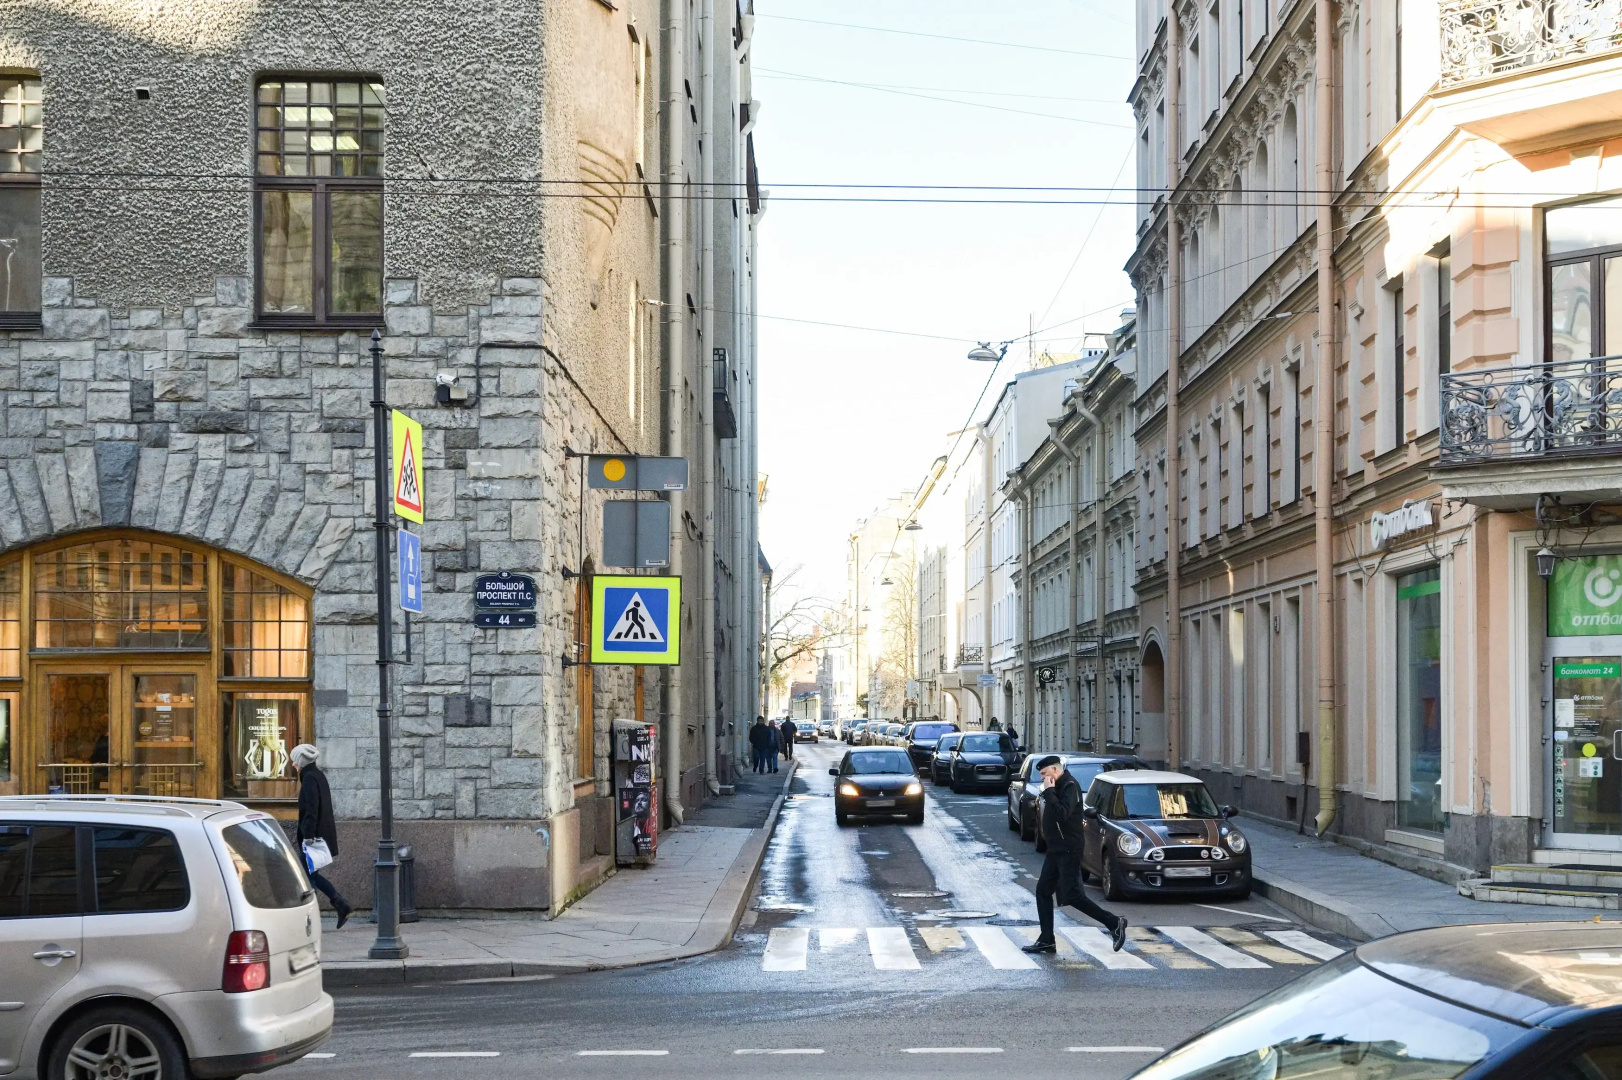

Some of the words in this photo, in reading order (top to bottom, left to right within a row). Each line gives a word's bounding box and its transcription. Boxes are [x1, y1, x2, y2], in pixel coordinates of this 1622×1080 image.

[485, 581, 525, 590] БОЛЬШОЙ
[476, 591, 517, 600] ПРОСПЕКТ
[518, 592, 534, 600] П.С.
[498, 615, 510, 625] 44
[1571, 612, 1622, 627] отпба
[1560, 667, 1601, 675] банкомат
